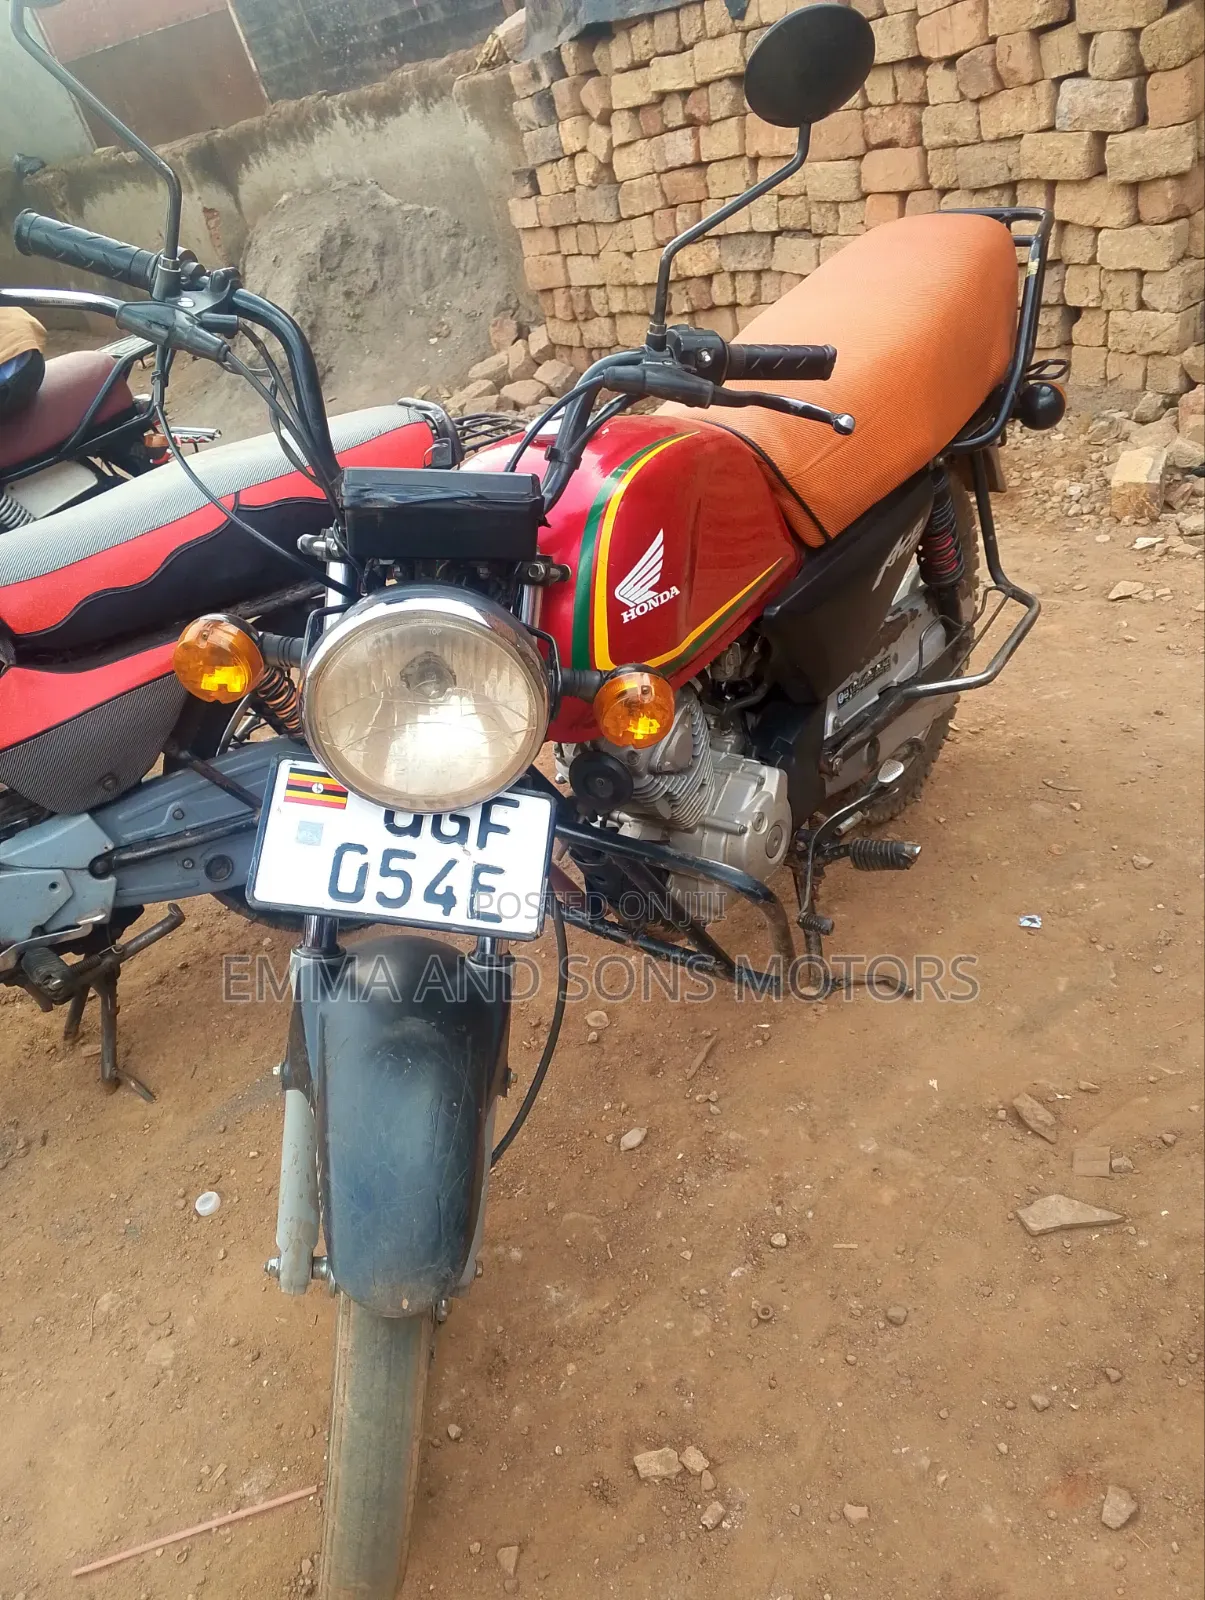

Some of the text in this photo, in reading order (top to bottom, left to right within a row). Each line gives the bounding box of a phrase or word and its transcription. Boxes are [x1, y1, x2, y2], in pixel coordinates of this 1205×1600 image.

[620, 585, 681, 624] HONDA
[427, 627, 442, 636] TOP
[327, 841, 505, 924] 054E
